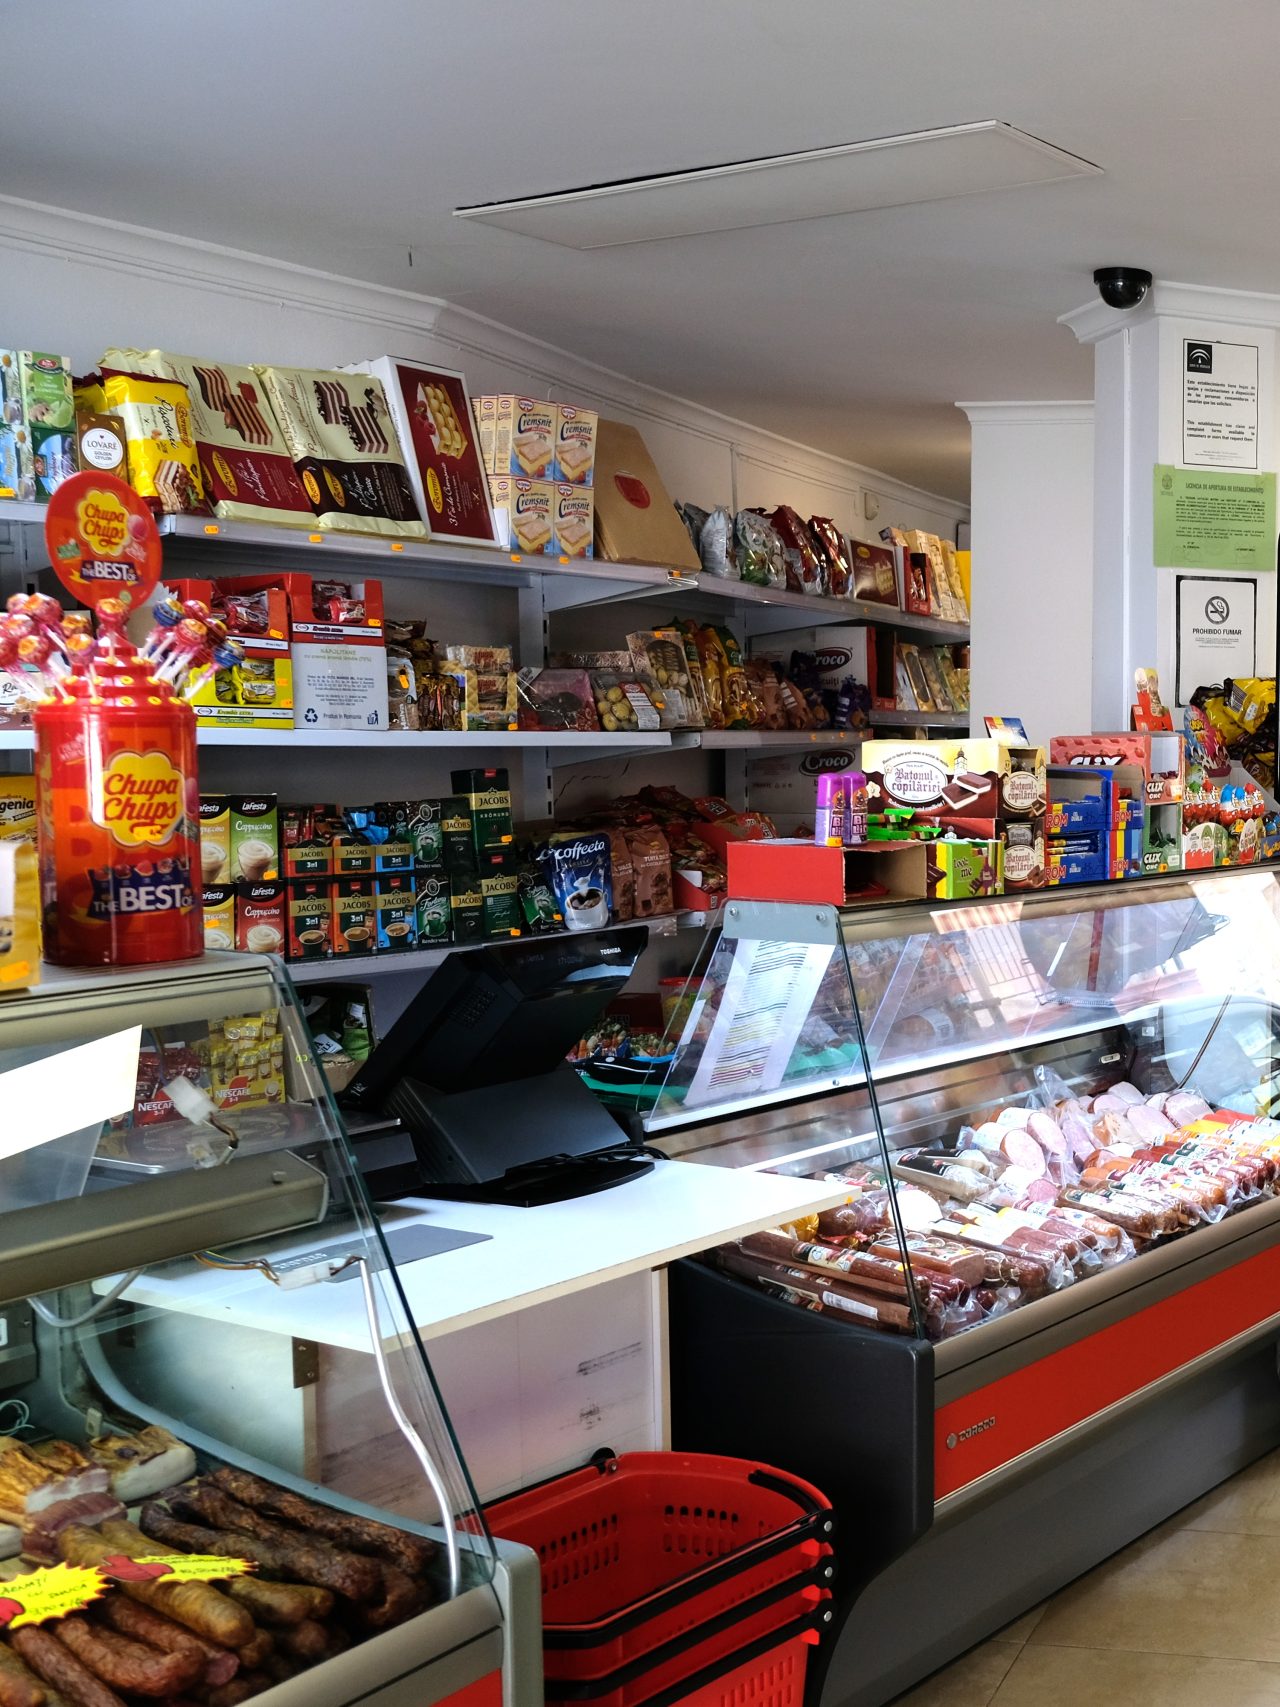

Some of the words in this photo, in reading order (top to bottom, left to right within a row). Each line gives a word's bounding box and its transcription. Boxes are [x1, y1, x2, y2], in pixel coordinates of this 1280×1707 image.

[85, 504, 125, 524] Chupa
[84, 520, 125, 538] Chups
[94, 561, 129, 580] BEST
[803, 754, 849, 770] Croco
[895, 769, 933, 781] Batonul
[104, 773, 178, 799] Chupa
[1147, 782, 1164, 793] CLIX
[479, 796, 509, 807] JACOBS
[103, 798, 177, 822] Chups
[446, 822, 471, 830] JACOBS
[1046, 813, 1068, 828] ROM
[236, 821, 272, 832] Cappuccino
[300, 850, 324, 858] JACOBS
[345, 849, 368, 857] JACOBS
[1144, 853, 1161, 864] CLIX
[1045, 865, 1066, 879] ROM
[485, 882, 516, 892] JACOBS
[93, 900, 118, 912] THE
[119, 884, 184, 911] BEST
[383, 897, 411, 907] JACOBS
[457, 896, 482, 904] JACOBS
[245, 906, 280, 917] Cappuccino
[298, 903, 327, 912] JACOBS
[342, 902, 371, 910] JACOBS
[600, 947, 621, 955] TOSHIBA
[138, 1101, 175, 1111] NESCAF
